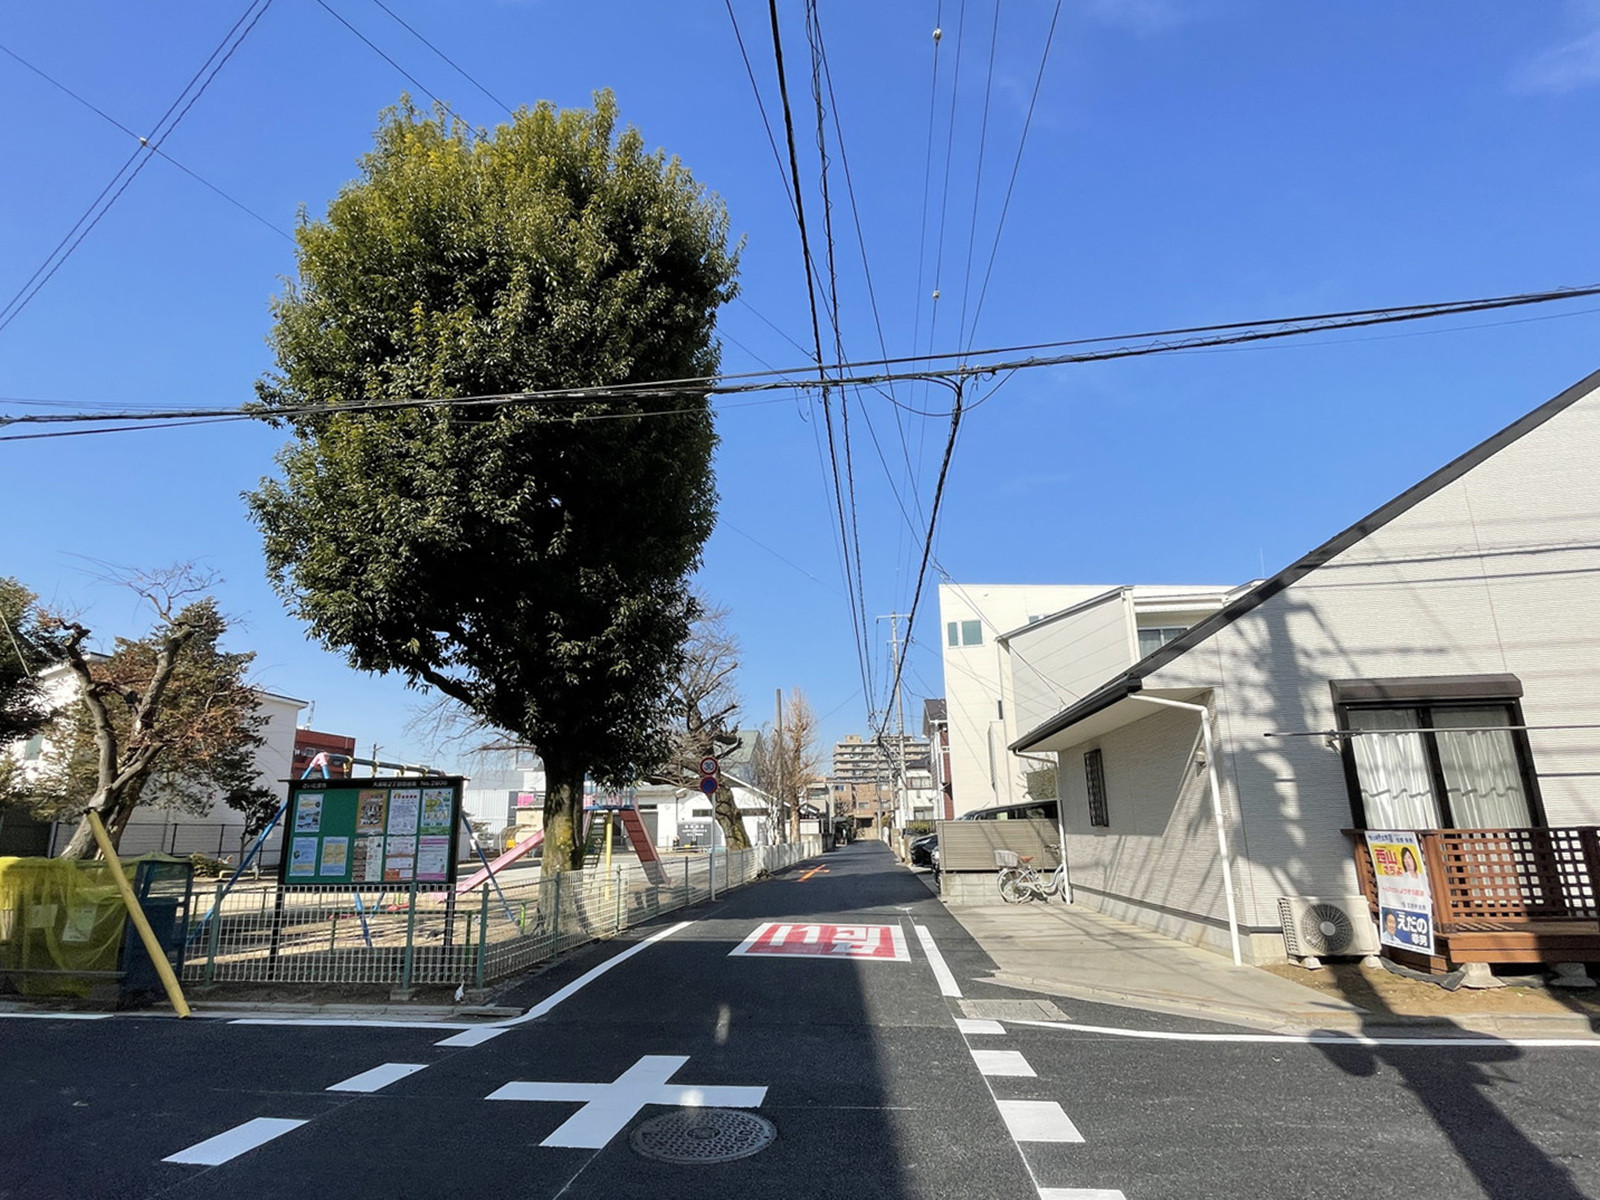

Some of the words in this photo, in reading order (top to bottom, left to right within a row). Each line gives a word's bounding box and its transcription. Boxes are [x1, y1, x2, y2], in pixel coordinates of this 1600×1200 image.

[703, 761, 715, 771] 30
[1374, 849, 1398, 865] 西山
[1397, 913, 1428, 934] えだの
